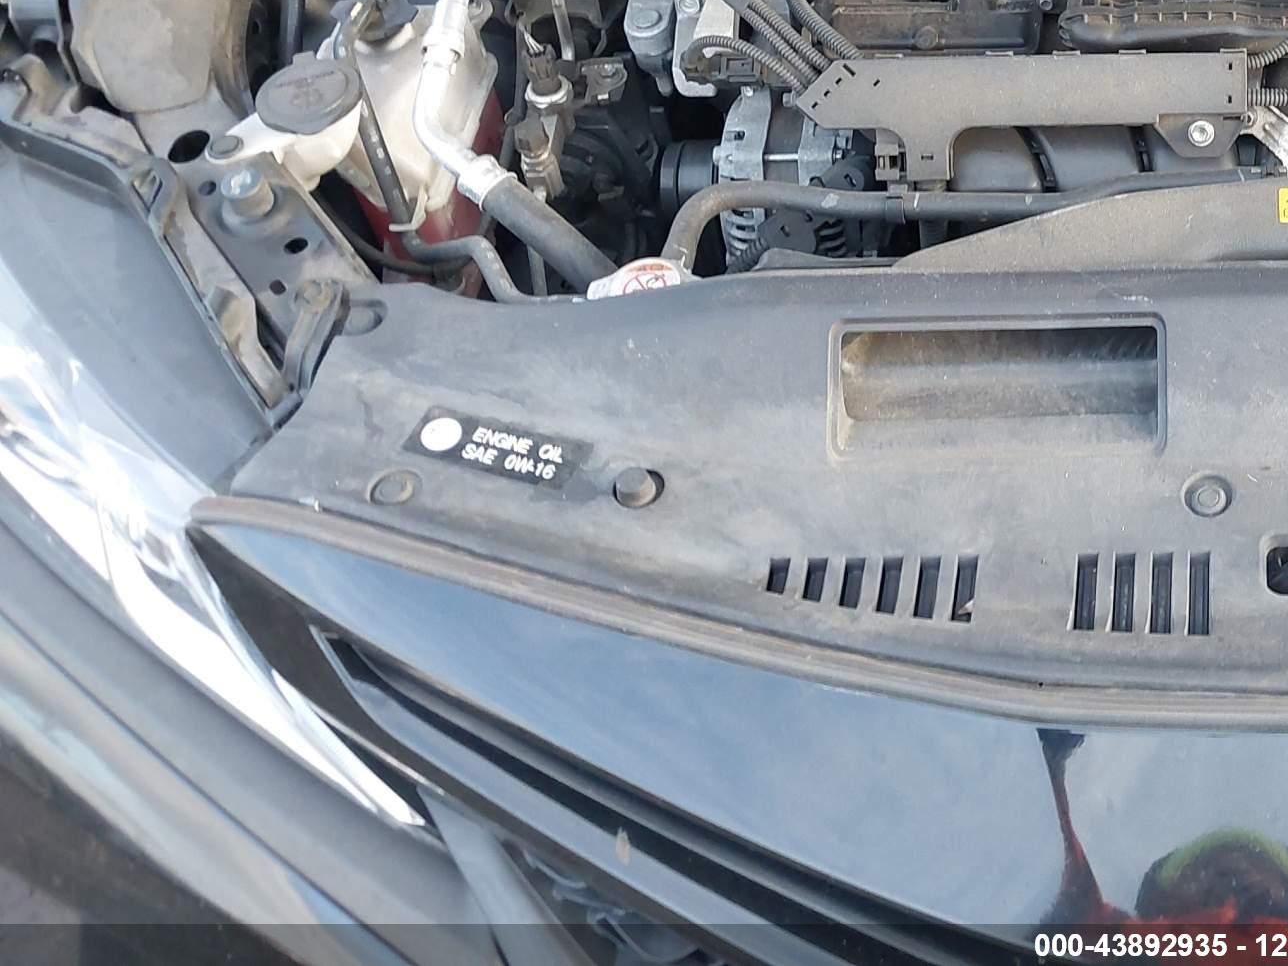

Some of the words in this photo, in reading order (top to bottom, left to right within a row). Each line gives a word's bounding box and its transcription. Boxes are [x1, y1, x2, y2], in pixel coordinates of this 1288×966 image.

[461, 443, 499, 466] SAE
[504, 454, 556, 480] 0W-16
[472, 426, 533, 455] ENGINE
[538, 444, 563, 464] OIL
